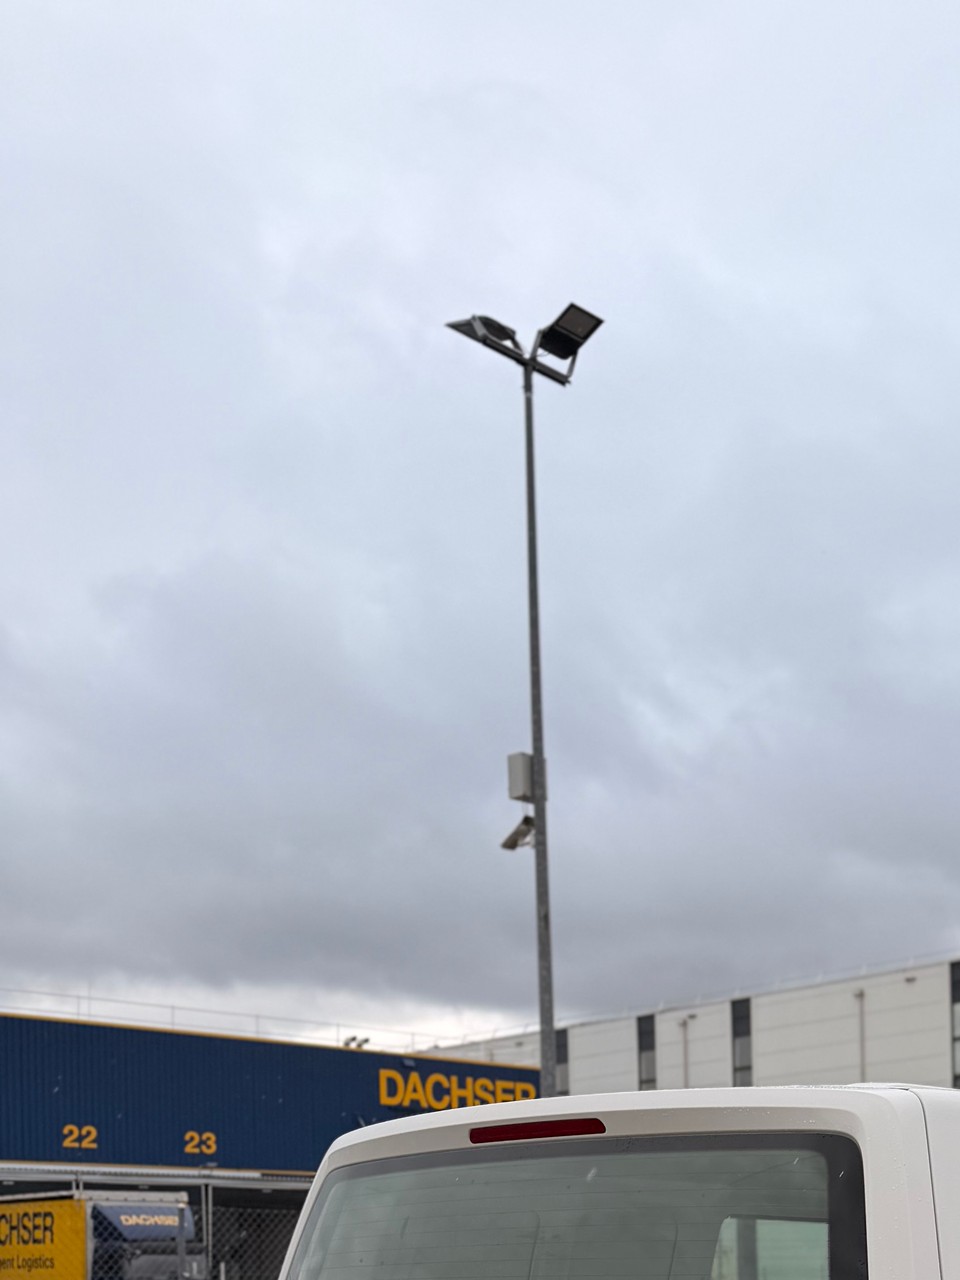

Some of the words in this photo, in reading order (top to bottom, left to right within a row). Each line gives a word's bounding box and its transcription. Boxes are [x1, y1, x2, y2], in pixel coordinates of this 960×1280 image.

[62, 1124, 97, 1149] 22
[184, 1130, 217, 1155] 23
[17, 1254, 54, 1272] Logistics
